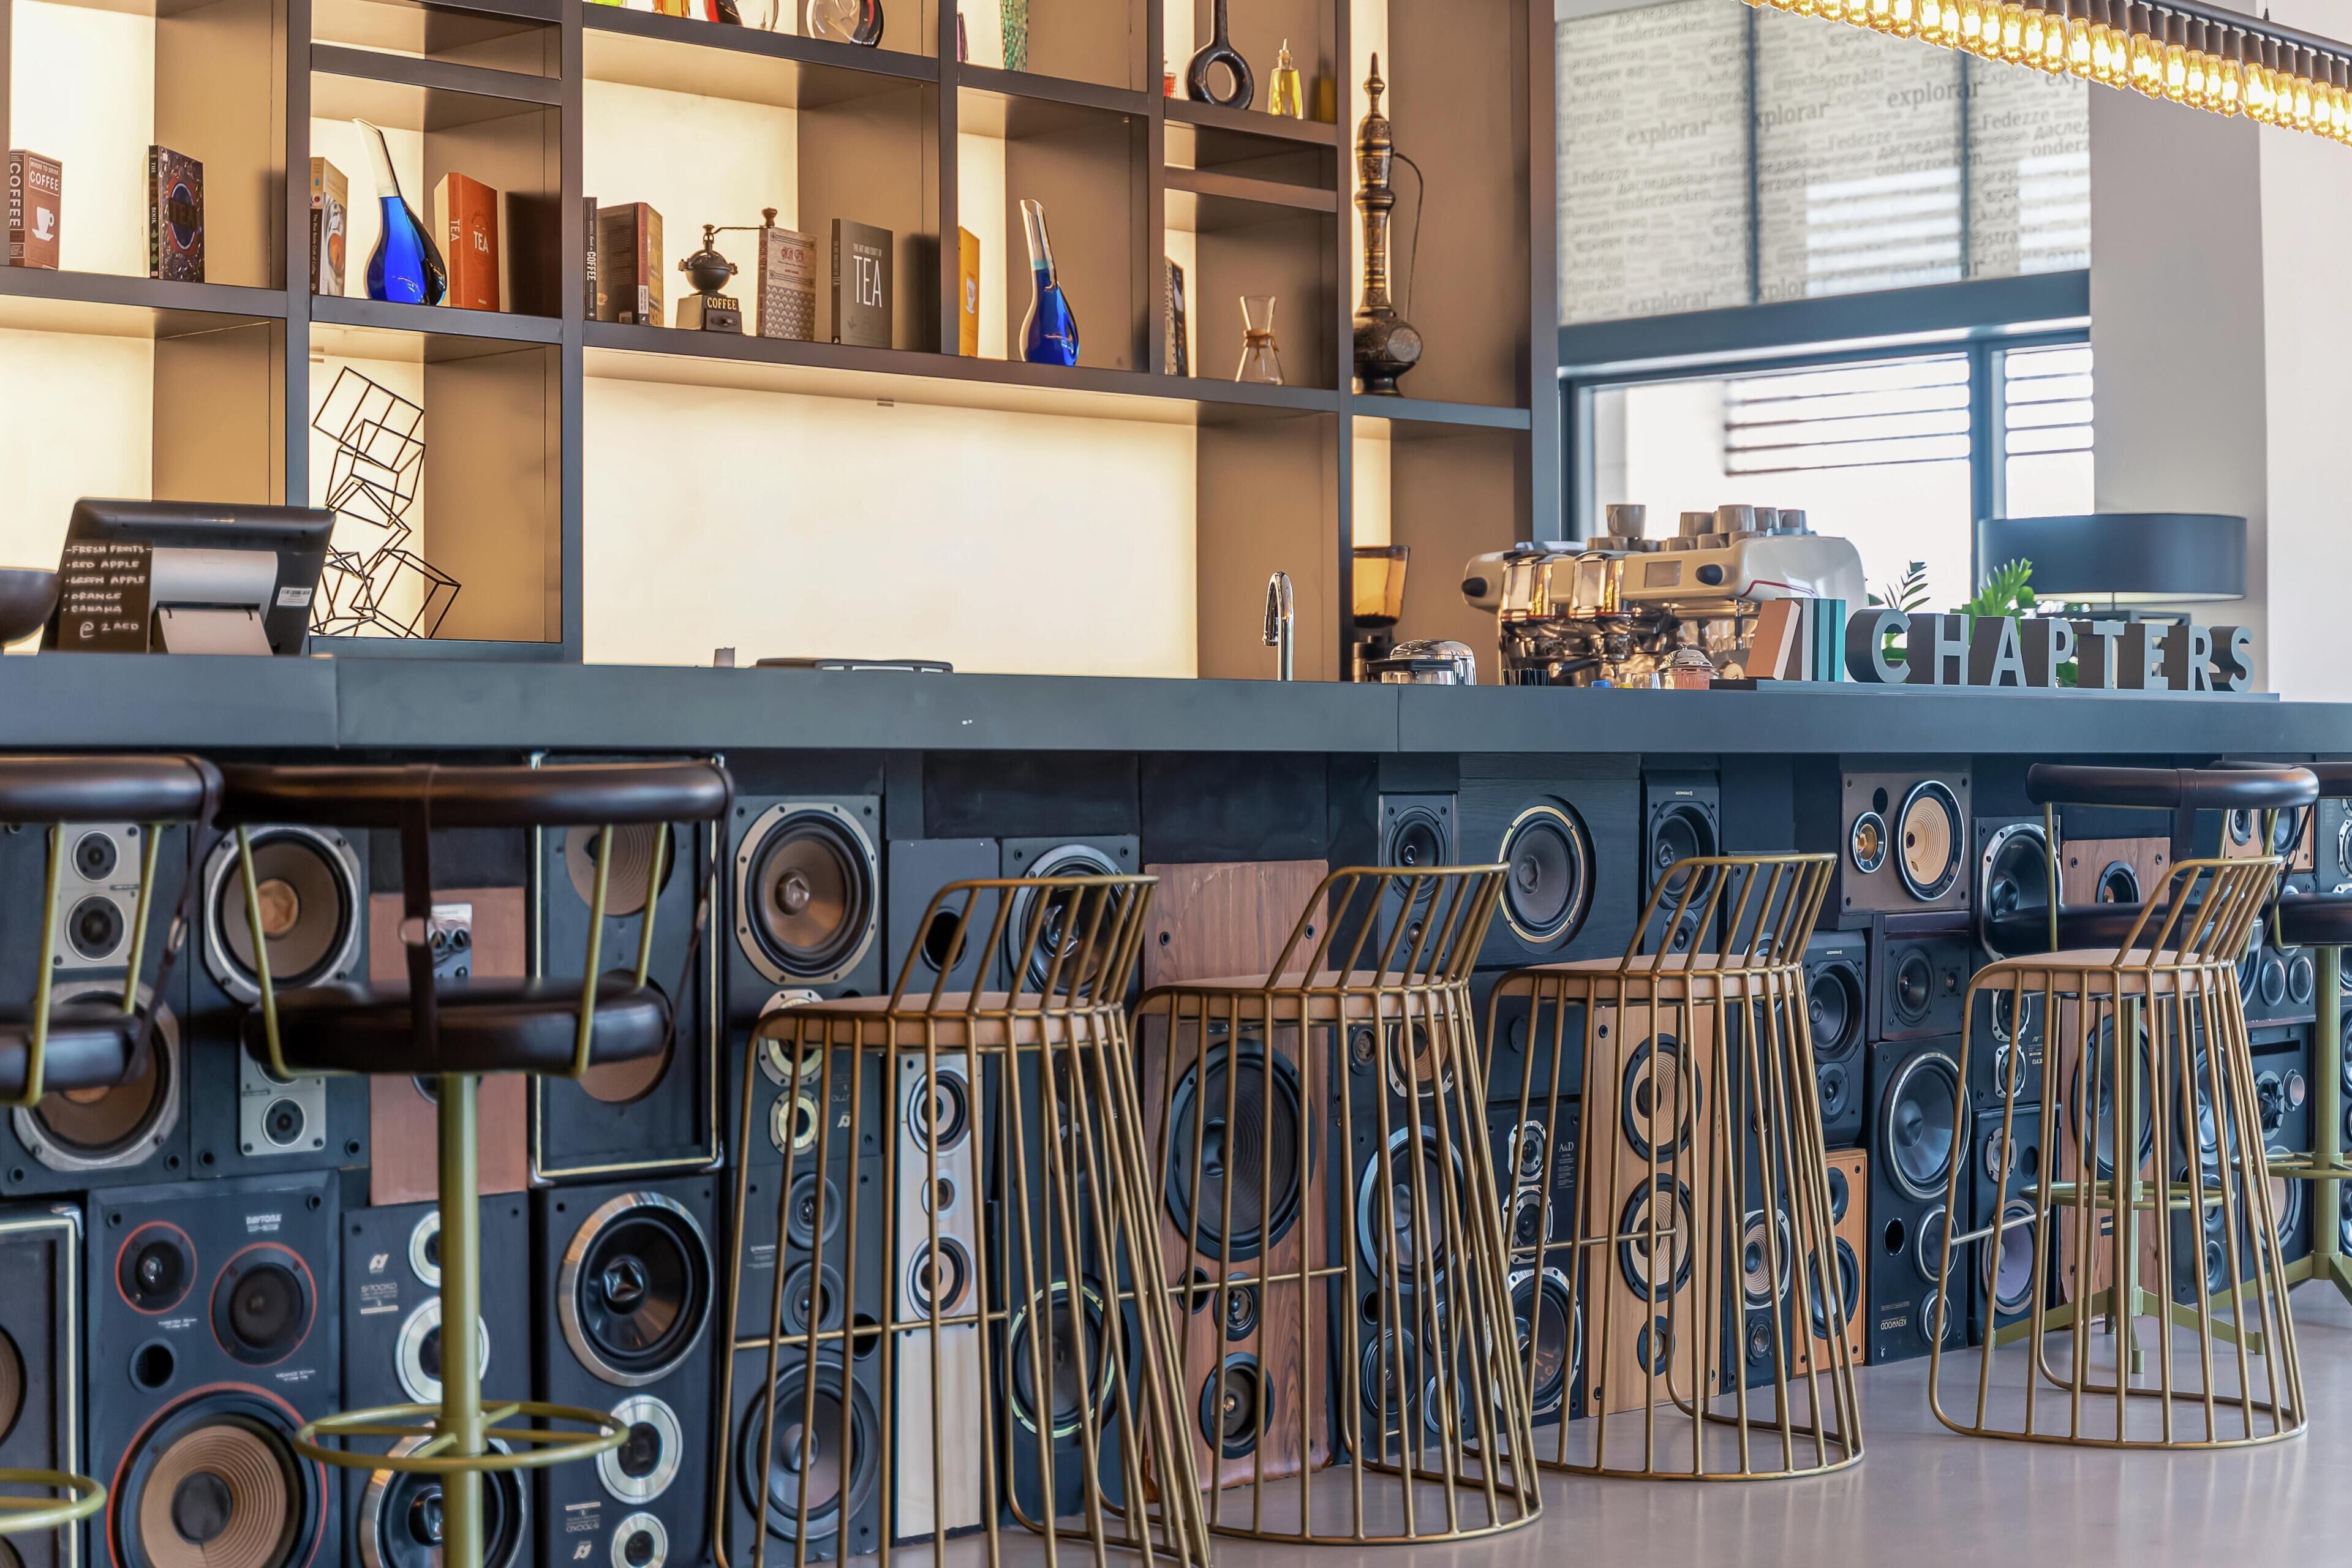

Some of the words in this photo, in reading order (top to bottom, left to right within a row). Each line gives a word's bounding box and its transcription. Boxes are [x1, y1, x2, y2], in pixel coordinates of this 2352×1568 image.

[1887, 81, 1984, 111] explorar
[1626, 118, 1712, 149] explorar
[30, 170, 59, 191] COFFEE
[10, 163, 21, 226] COFFEE
[450, 219, 460, 241] TEA
[473, 230, 489, 254] TEA
[587, 251, 597, 281] COFFEE
[853, 255, 882, 307] TEA
[707, 297, 737, 310] COFFEE
[1860, 609, 2255, 693] CHAPTERS
[1559, 1142, 1574, 1152] A&D
[1881, 1319, 1907, 1330] KENWOOD
